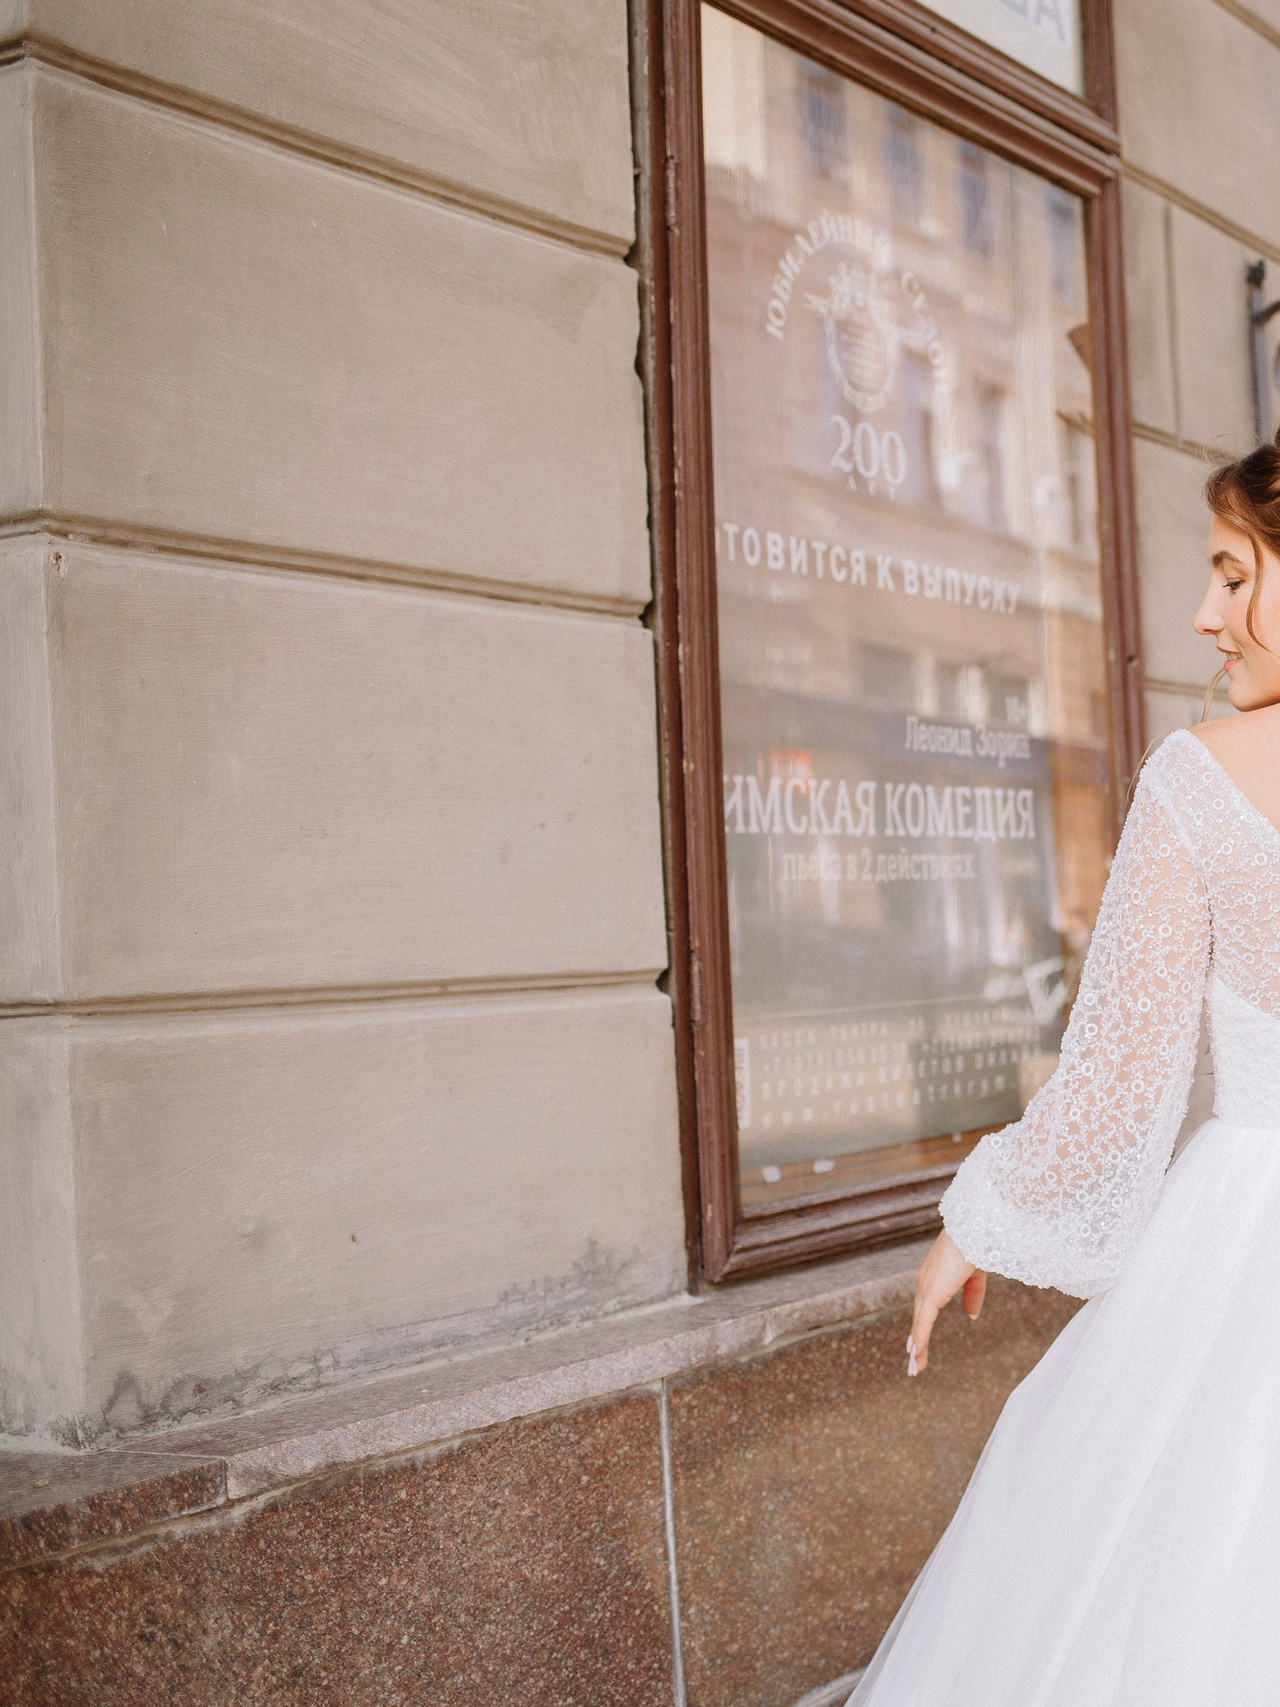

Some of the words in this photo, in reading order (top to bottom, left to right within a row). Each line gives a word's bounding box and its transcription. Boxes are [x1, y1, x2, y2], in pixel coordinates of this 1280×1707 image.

[829, 413, 907, 486] 200
[715, 521, 867, 587] ТОВИТСЯ
[877, 554, 896, 592] К
[902, 558, 1021, 615] ВЫПУСКУ
[884, 781, 1036, 843] КОМЕДИЯ
